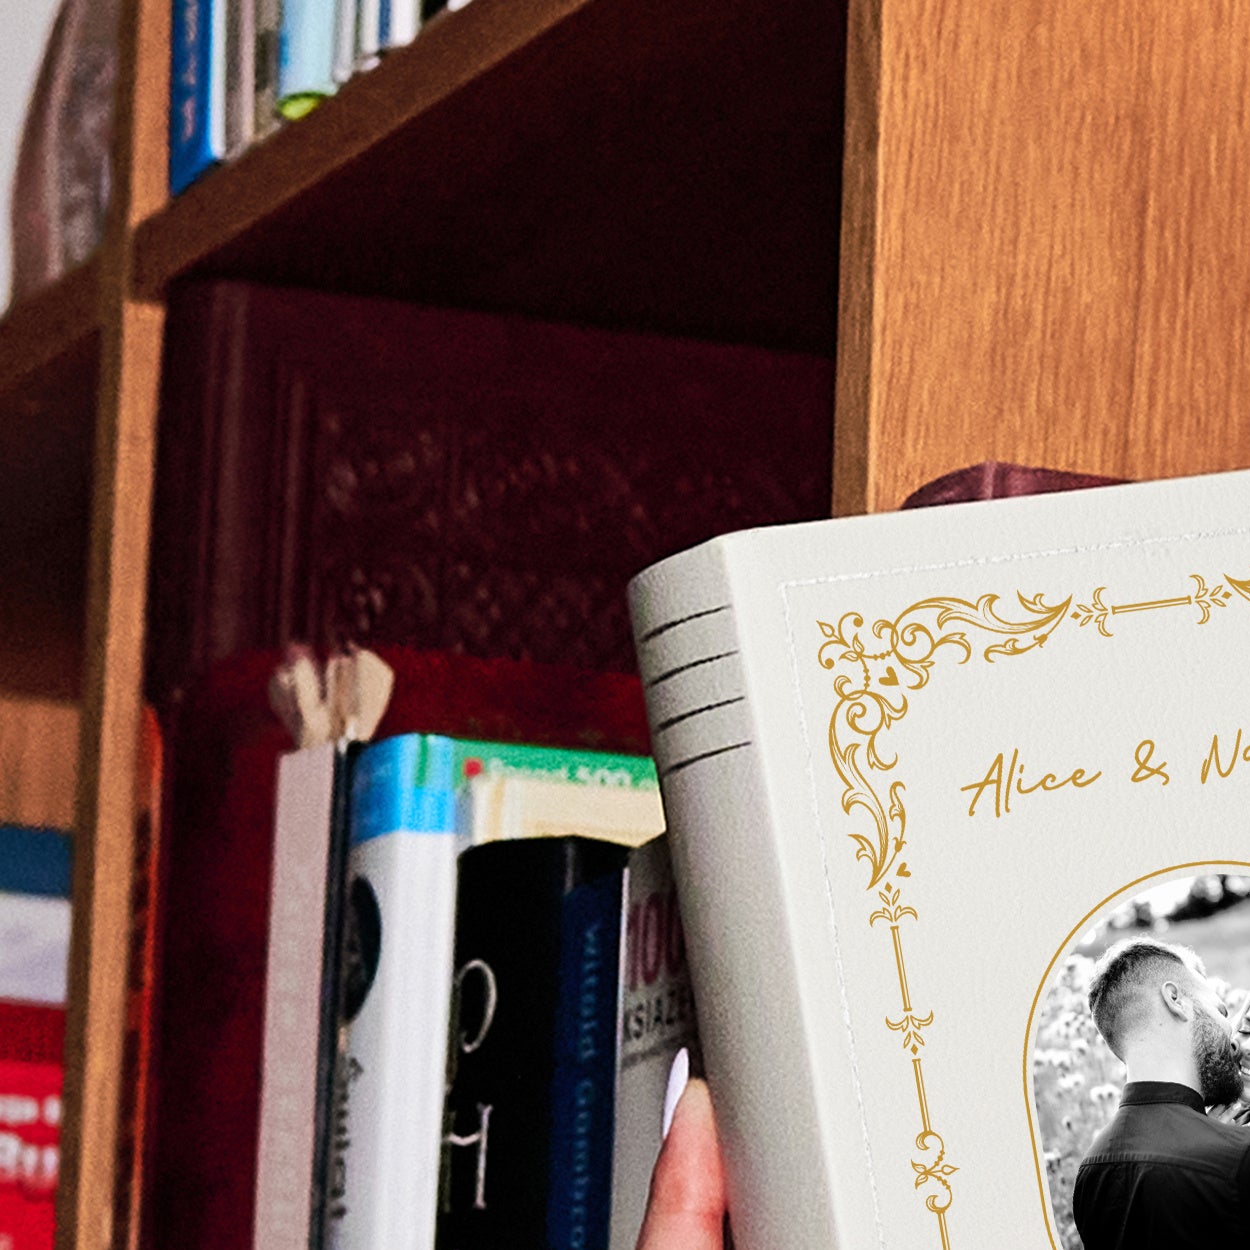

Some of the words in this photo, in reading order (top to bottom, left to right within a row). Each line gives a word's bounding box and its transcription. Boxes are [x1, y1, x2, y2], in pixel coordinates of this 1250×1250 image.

[960, 749, 1102, 818] Alice
[1131, 740, 1169, 786] &
[580, 920, 601, 1062] Witold
